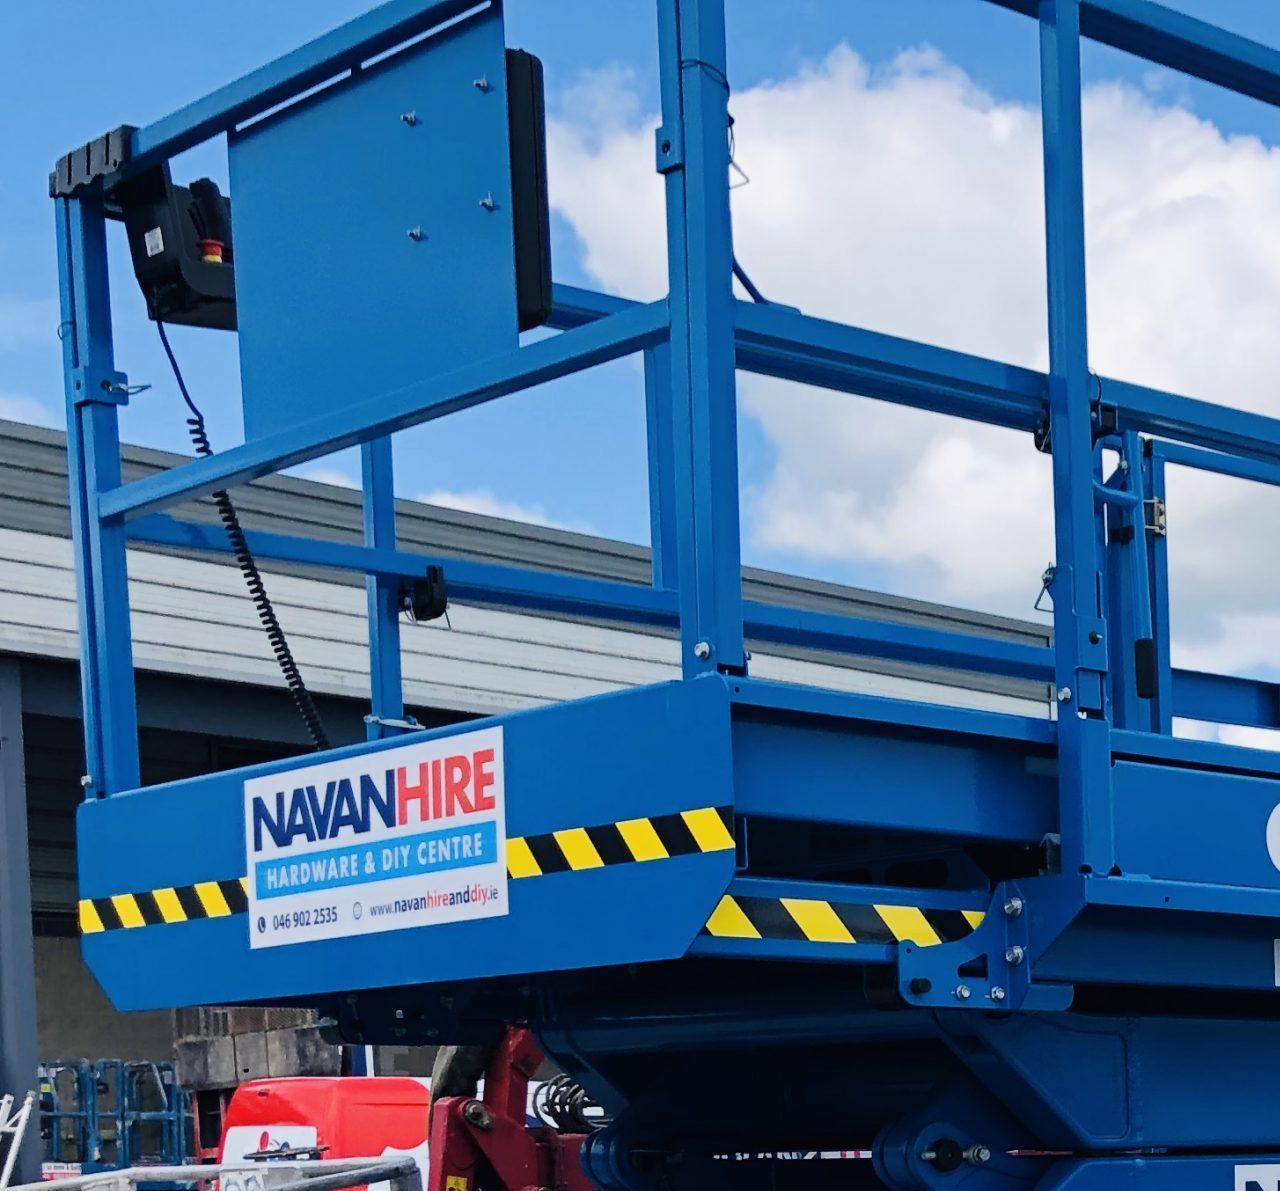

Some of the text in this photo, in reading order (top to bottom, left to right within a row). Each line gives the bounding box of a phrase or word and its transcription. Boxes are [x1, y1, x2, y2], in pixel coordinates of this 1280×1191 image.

[252, 748, 496, 852] NAVANHIRE
[267, 832, 483, 890] HARDWARE & DIY CENTRE
[273, 884, 499, 930] 046 902 2535 www.navanhireanddiy.ie
